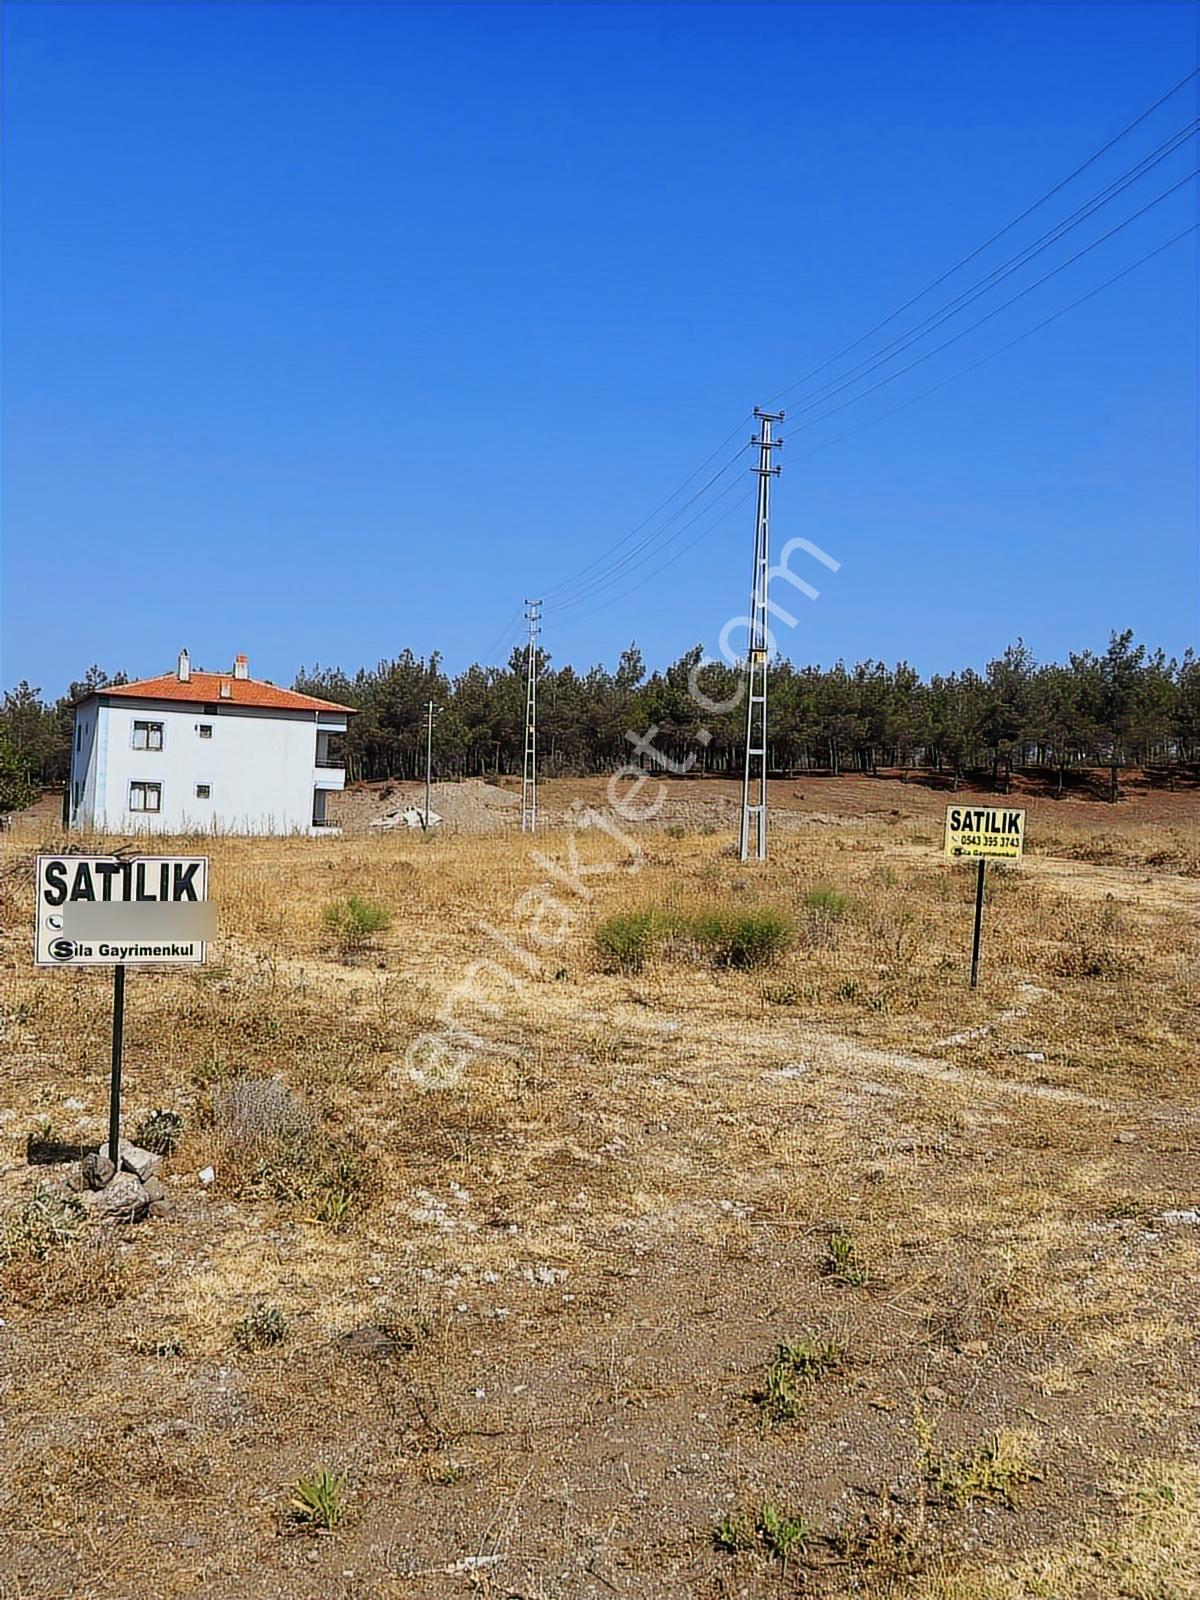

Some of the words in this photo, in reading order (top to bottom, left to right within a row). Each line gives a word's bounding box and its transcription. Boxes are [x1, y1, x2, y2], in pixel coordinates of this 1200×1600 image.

[950, 810, 1021, 834] SATILIK
[961, 835, 981, 846] 0543
[1000, 837, 1020, 848] 3743
[44, 861, 200, 906] SATILIK
[99, 943, 194, 959] Gayrimenkul
